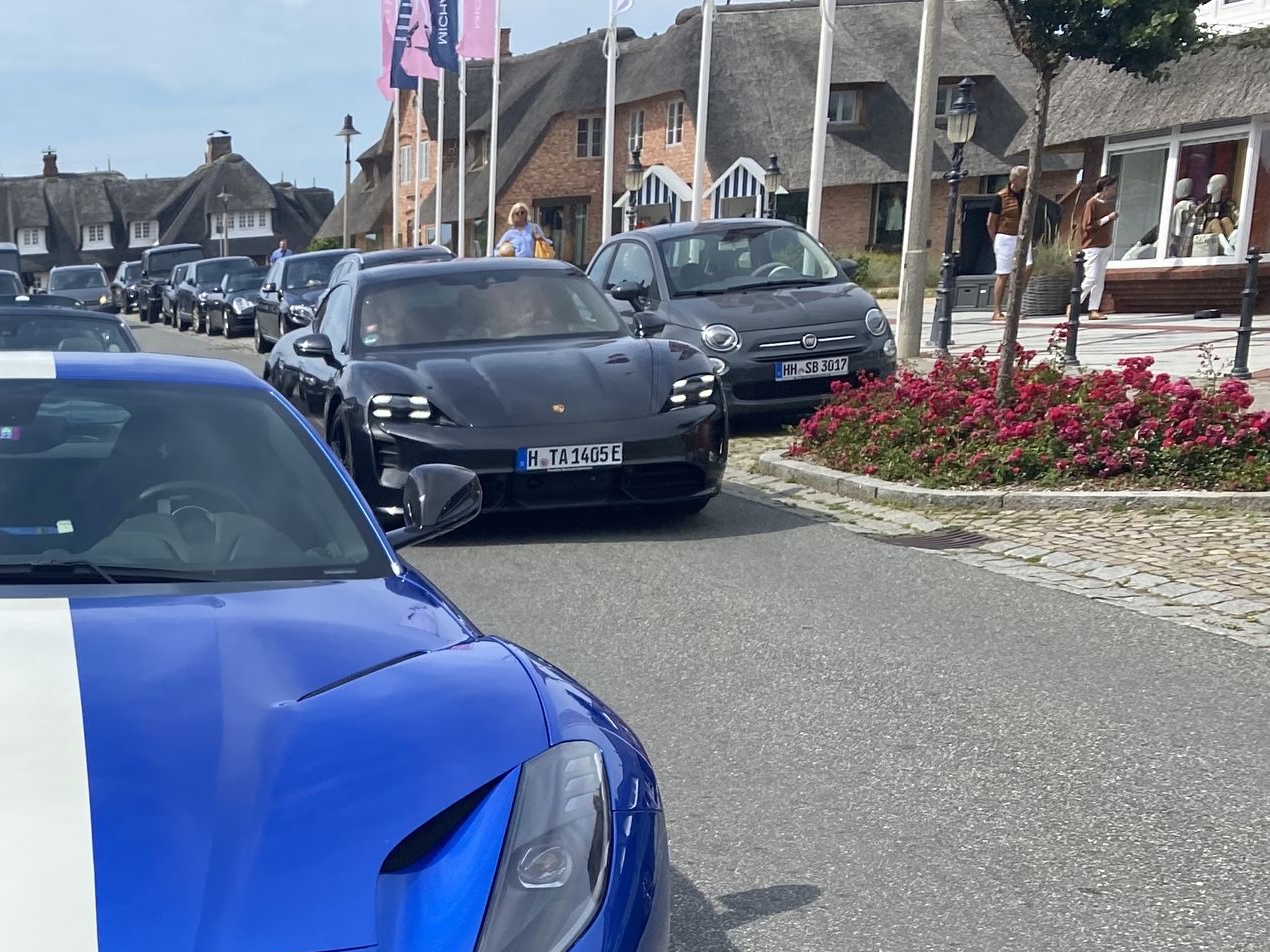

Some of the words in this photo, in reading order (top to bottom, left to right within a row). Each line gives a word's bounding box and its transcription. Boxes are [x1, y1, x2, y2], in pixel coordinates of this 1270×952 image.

[783, 363, 798, 376] HH
[805, 361, 819, 374] SB
[821, 358, 847, 372] 3017
[528, 450, 538, 467] H
